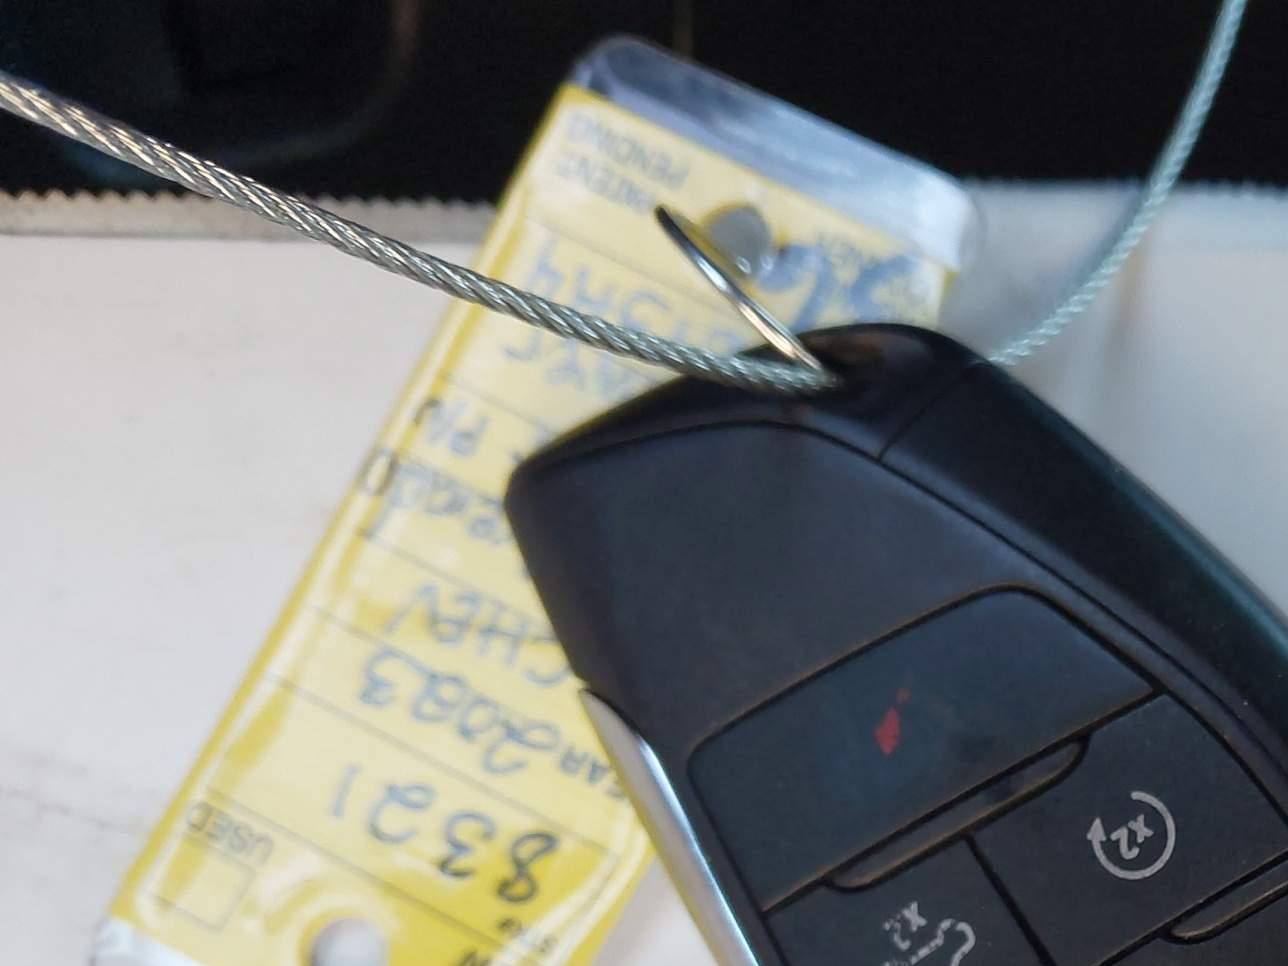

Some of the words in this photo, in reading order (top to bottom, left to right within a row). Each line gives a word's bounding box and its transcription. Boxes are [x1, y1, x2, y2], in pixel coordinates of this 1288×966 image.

[359, 646, 560, 774] 2023
[559, 746, 626, 800] EAR
[184, 801, 274, 865] USED
[331, 764, 558, 902] 8321
